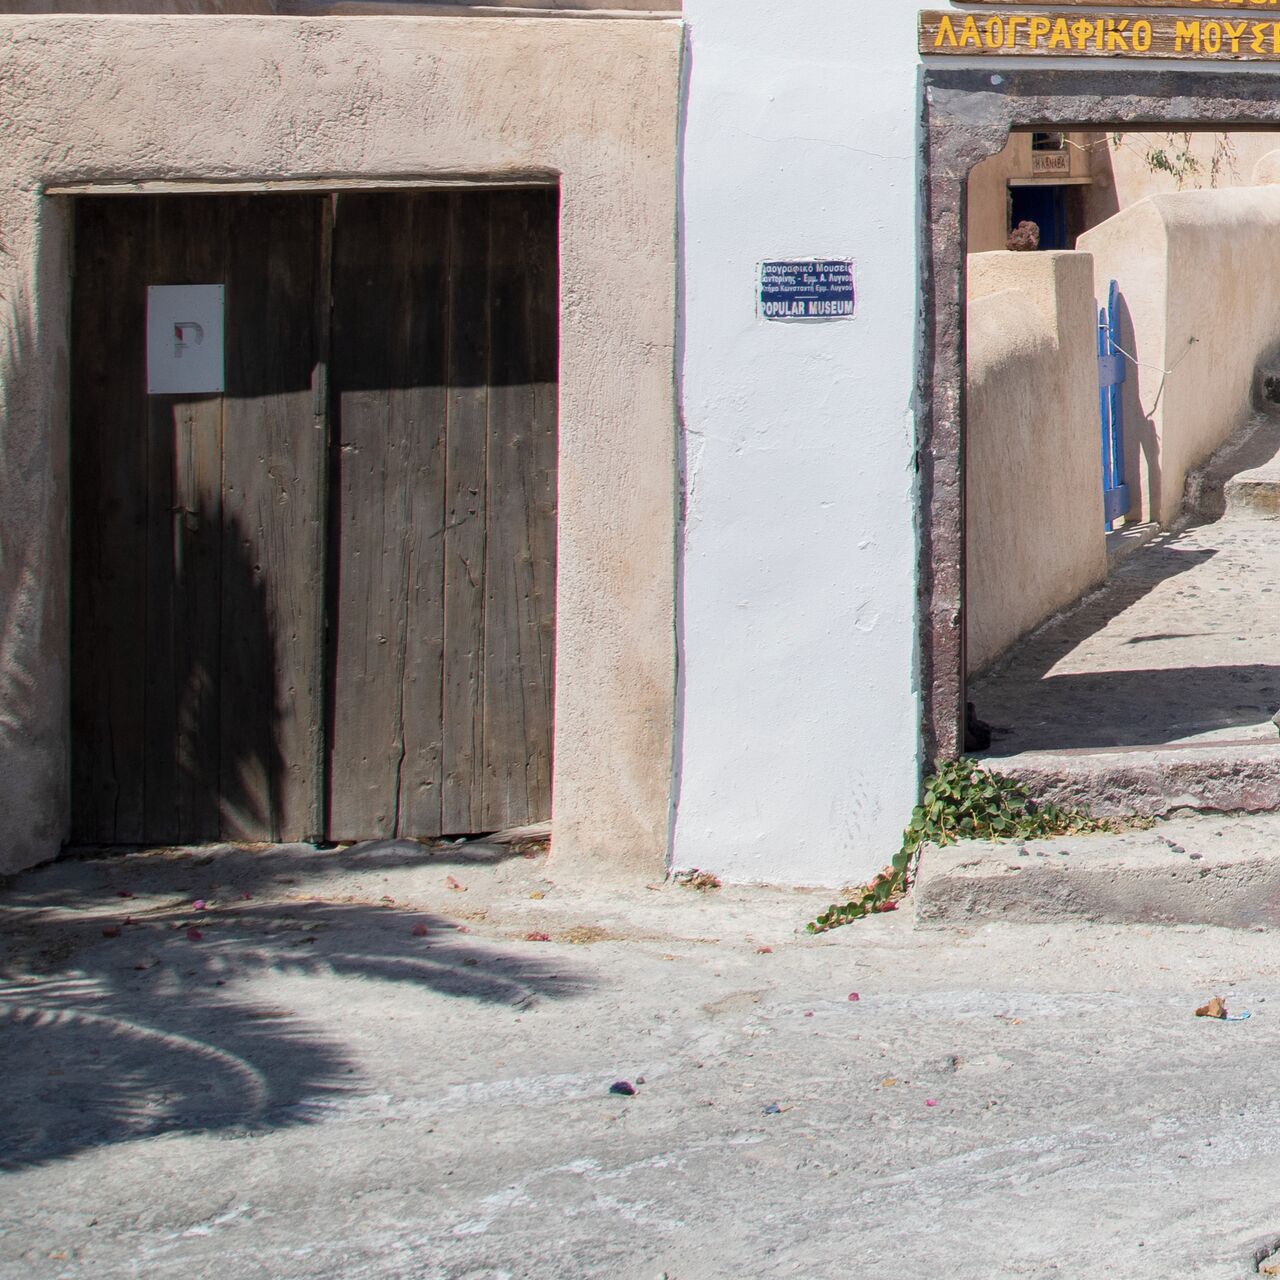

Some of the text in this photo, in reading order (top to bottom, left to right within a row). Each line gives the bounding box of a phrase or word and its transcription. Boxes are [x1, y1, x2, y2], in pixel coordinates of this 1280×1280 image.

[934, 15, 1152, 52] ΛΑΟΓΡΑΦΙΚΟ
[762, 274, 796, 284] αντορίνης
[761, 300, 853, 315] POPULAR MUSEUM
